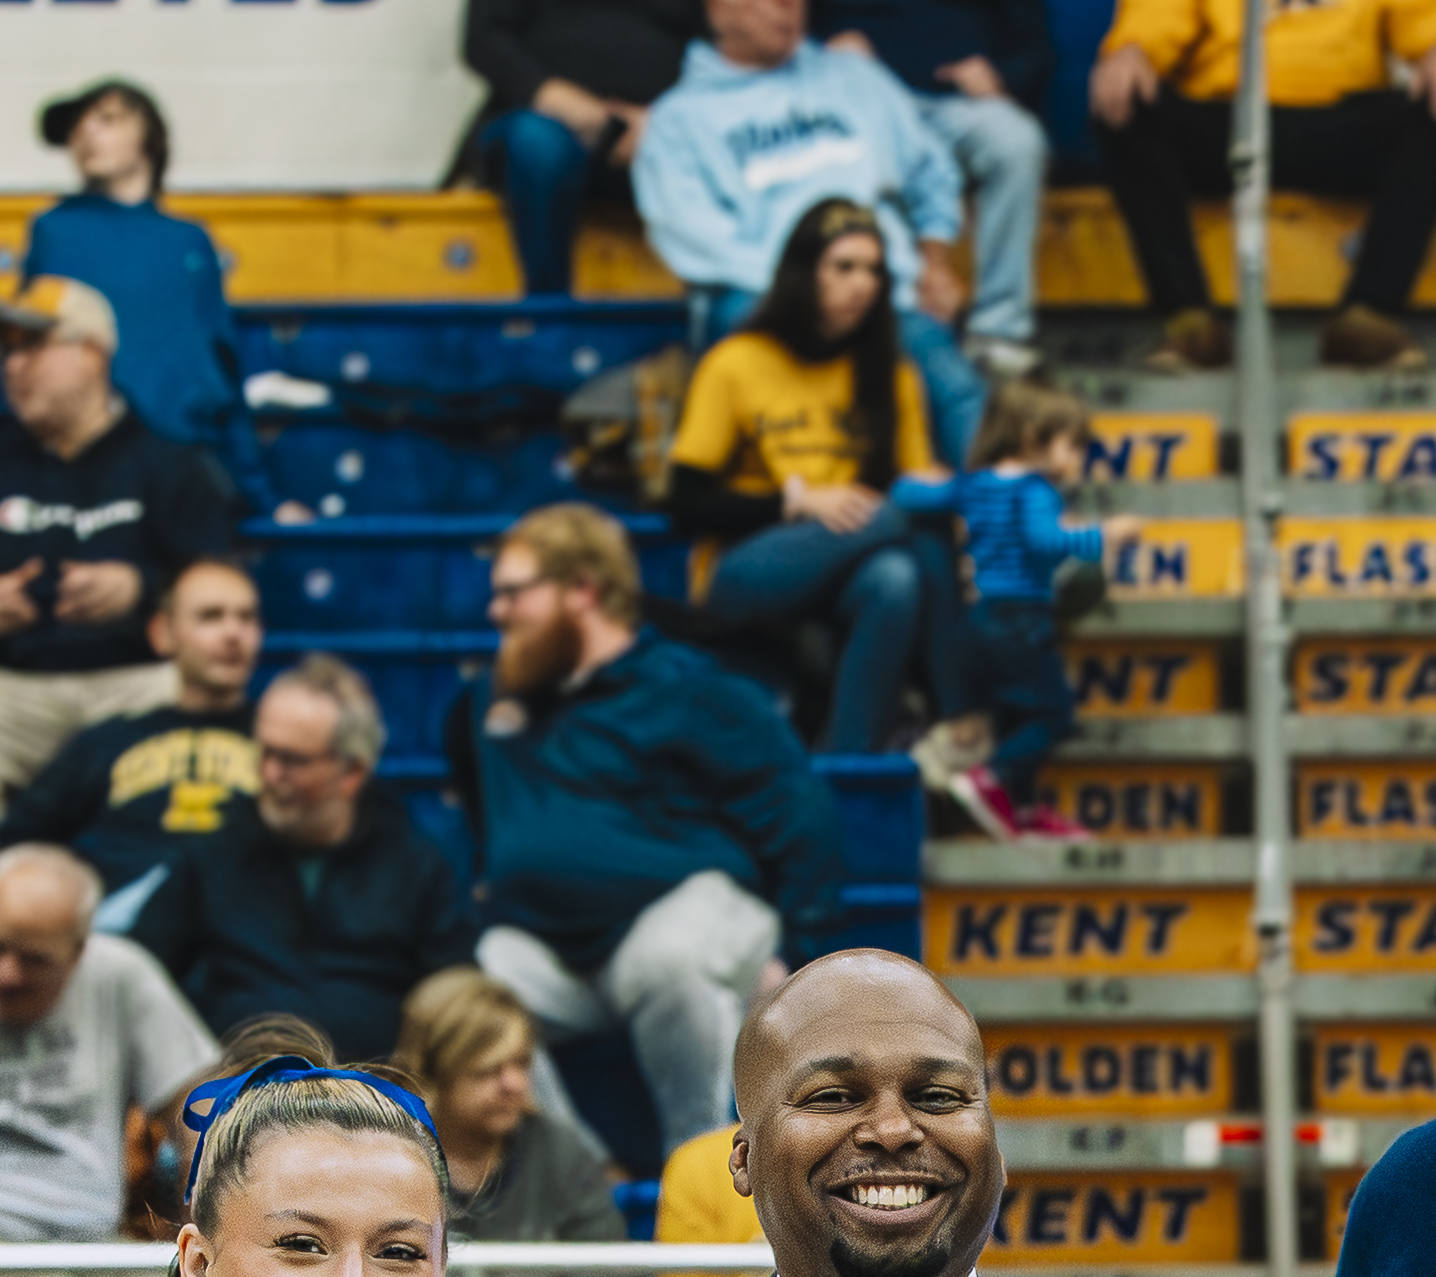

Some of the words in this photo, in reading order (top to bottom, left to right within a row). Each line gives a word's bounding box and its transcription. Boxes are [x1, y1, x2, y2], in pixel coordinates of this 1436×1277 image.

[1086, 434, 1186, 480] NT
[1076, 655, 1190, 702] NT
[951, 903, 1187, 957] KENT
[998, 1045, 1212, 1094] OLDEN
